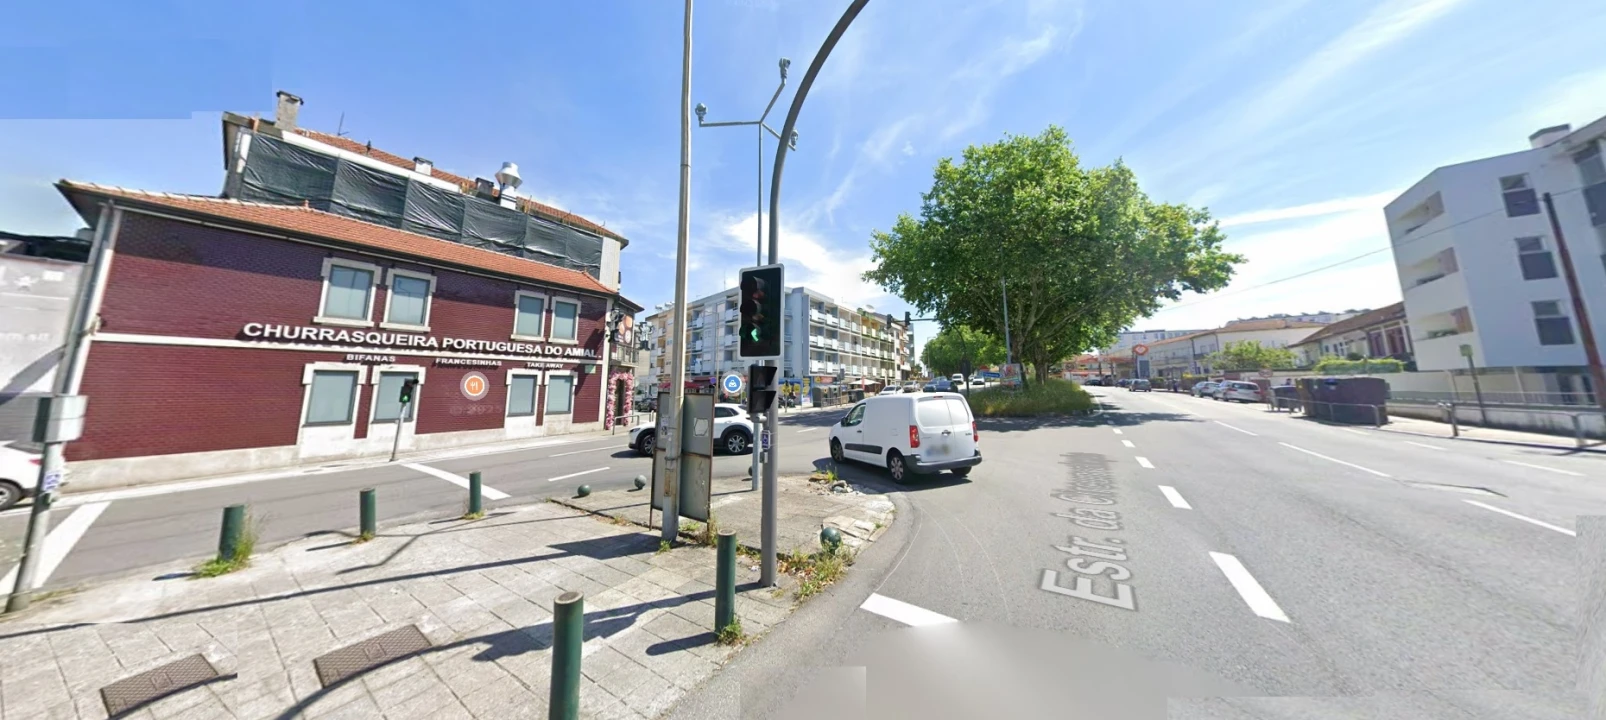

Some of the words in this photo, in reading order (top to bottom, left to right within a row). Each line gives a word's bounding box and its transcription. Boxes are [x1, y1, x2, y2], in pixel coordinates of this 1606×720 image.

[243, 322, 439, 347] CHURRASQUEIRA
[442, 337, 542, 355] PORTUGUESA
[545, 346, 563, 356] DO
[346, 353, 396, 362] BIFANAS
[435, 357, 502, 367] FRANCESINHAS
